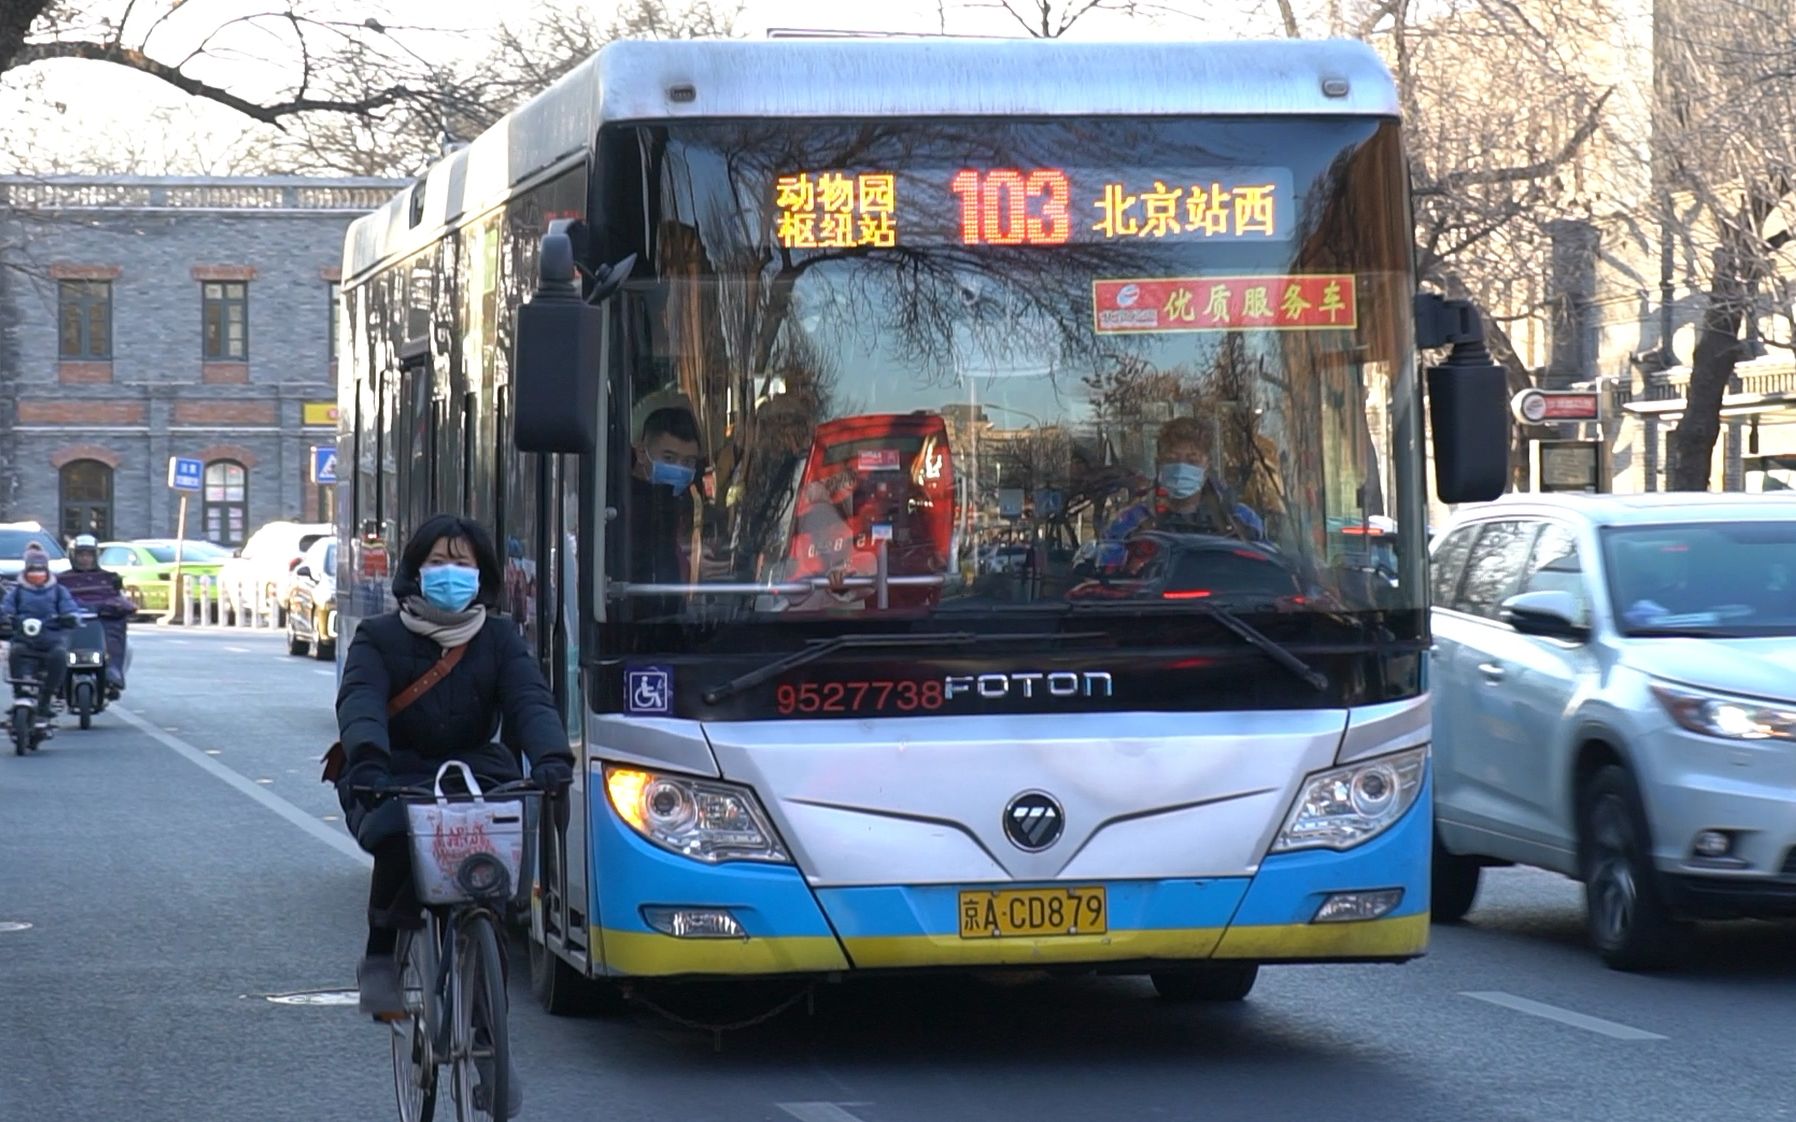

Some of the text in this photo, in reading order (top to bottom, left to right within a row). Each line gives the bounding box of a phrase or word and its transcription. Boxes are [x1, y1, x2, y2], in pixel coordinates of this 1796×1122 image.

[776, 172, 896, 213] 动物园
[952, 170, 1071, 245] 103
[1092, 181, 1276, 238] 北京站西
[777, 211, 897, 248] 枢纽站
[1163, 280, 1346, 323] 优质服务车
[776, 681, 943, 714] 9527738
[945, 672, 1113, 699] FOTON
